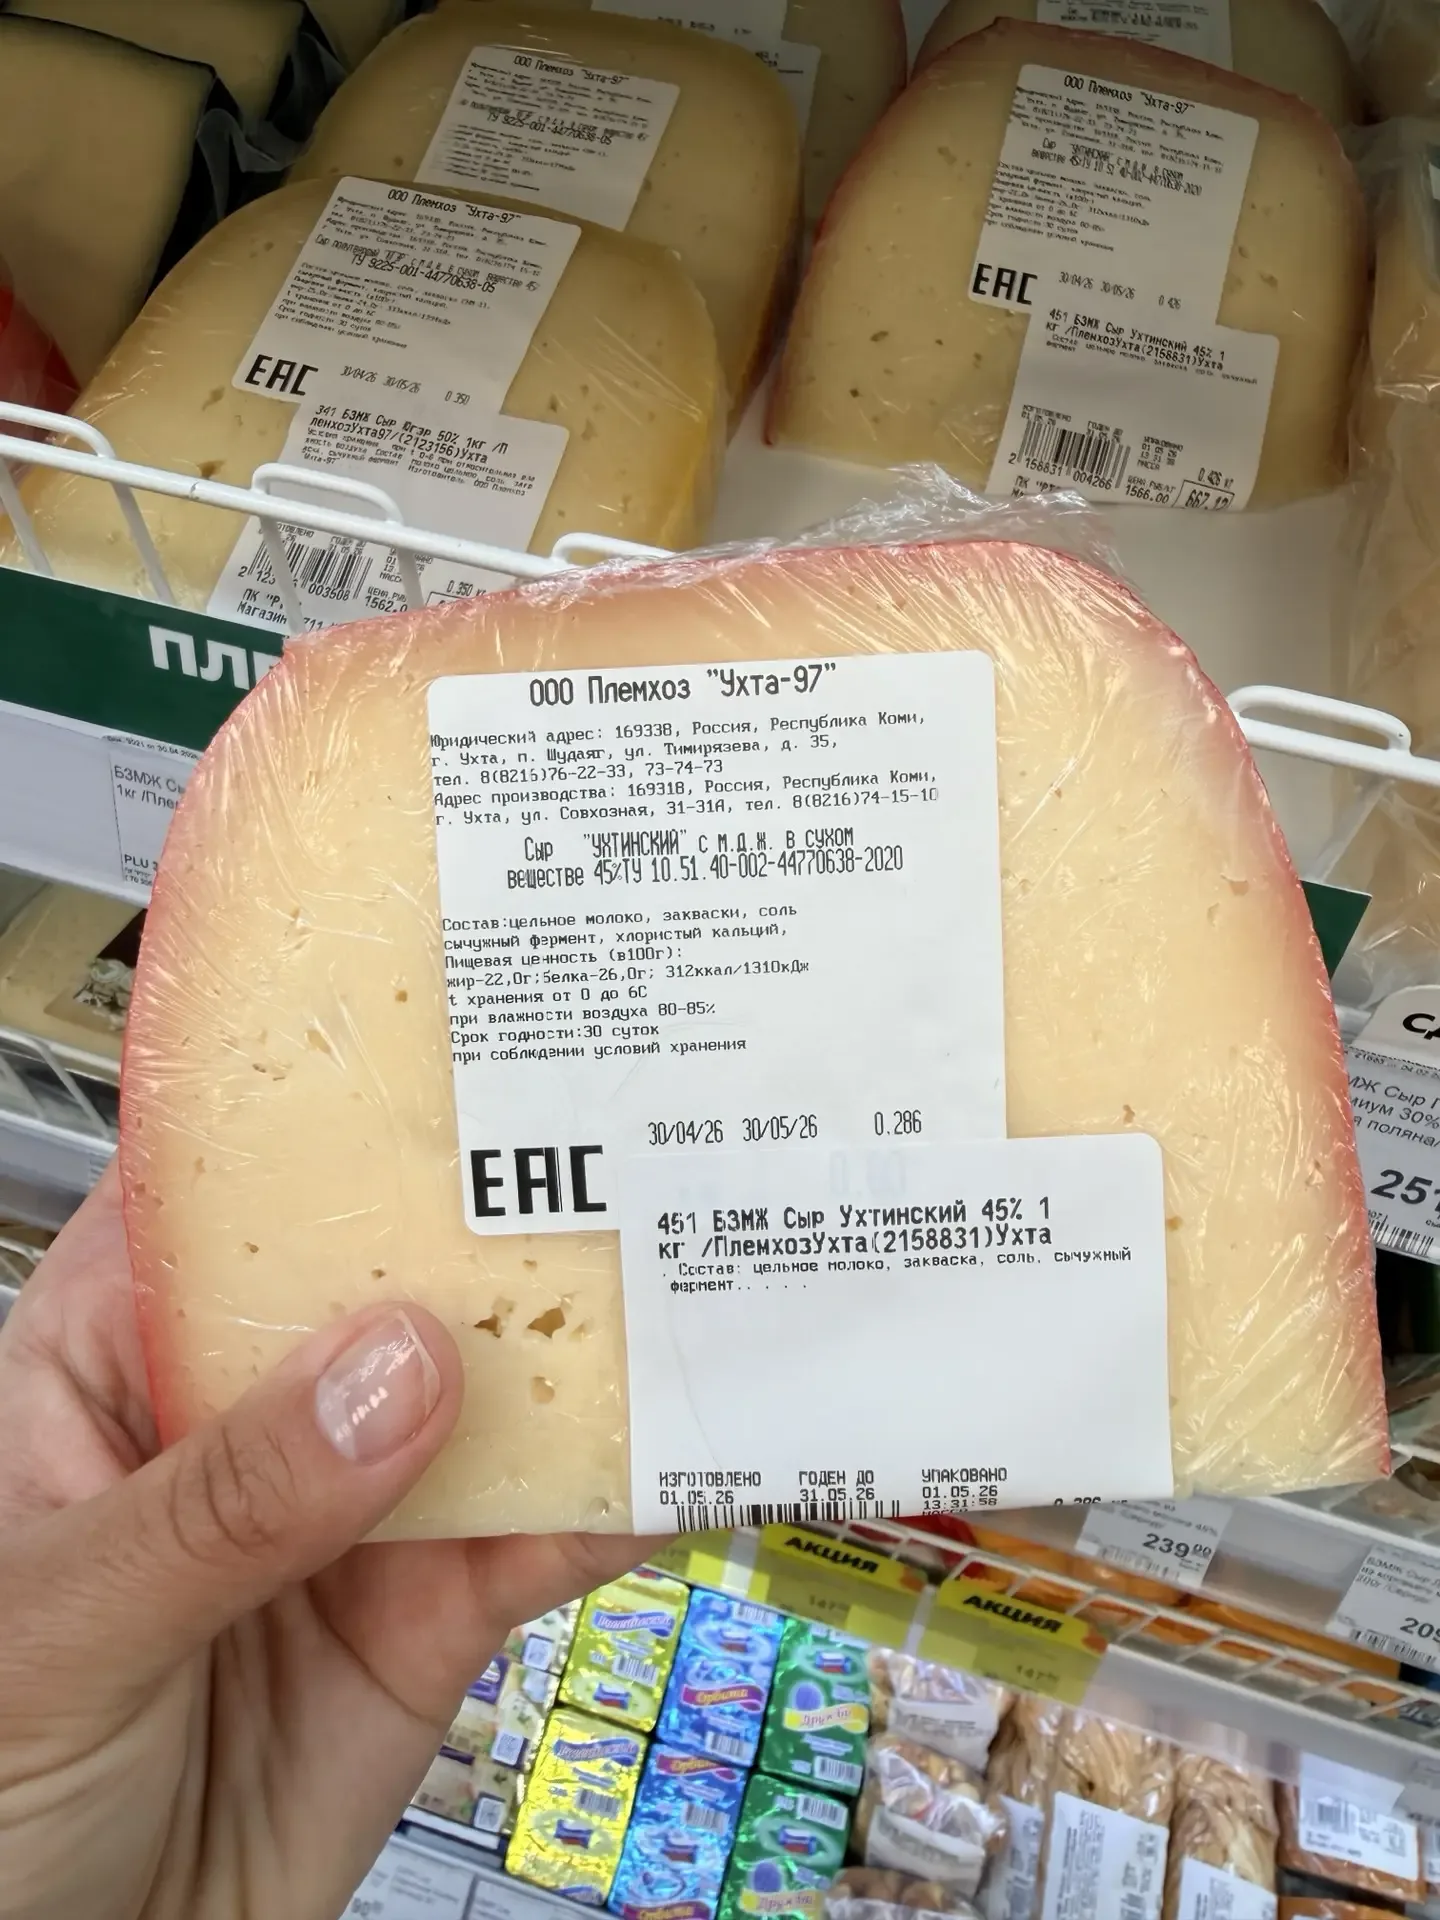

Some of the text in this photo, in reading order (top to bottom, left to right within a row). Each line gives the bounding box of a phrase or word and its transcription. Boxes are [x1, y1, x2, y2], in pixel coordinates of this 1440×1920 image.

[388, 189, 409, 202] ООО
[412, 193, 457, 213] Племхоз
[1050, 309, 1068, 322] 451
[1106, 322, 1124, 335] Сыр
[1220, 351, 1224, 361] 1
[315, 405, 336, 417] 341
[376, 415, 396, 431] Сыр
[437, 430, 460, 444] 50%
[467, 437, 486, 449] 1кг
[1073, 471, 1112, 490] 004266
[1126, 484, 1169, 504] 1566.00
[308, 581, 350, 601] 003508
[530, 663, 836, 707] ООО Племхоз "Ухта-97"
[430, 712, 923, 751] Юридический адрес: 169338, Россия, Республика Коми,
[430, 734, 836, 768] г. Ухта, п. Шудаяг, ул. Тимирязева, д. 35,
[114, 766, 162, 789] БЗМЖ
[434, 776, 468, 786] тел.
[645, 760, 722, 776] 73-74-73
[116, 784, 178, 810] 1кг /Пле
[434, 770, 935, 809] Адрес производства: 169318, Россия, Республика Коми,
[434, 816, 451, 825] г.
[464, 811, 509, 824] Ухта,
[522, 811, 547, 825] ул.
[560, 806, 654, 819] Совхозная,
[746, 800, 780, 810] тел.
[793, 788, 936, 808] 8(8216)74-15-10
[525, 837, 553, 862] Сыр
[584, 830, 686, 858] "УХТИНСКИЙ"
[124, 855, 149, 869] PLU
[508, 867, 584, 889] веществе
[442, 906, 797, 931] Состав:цельное молоко, закваски, соль
[444, 924, 786, 952] сычужный фермент, хлористый кальций,
[445, 943, 681, 970] Пищевая ценность (в100г):
[448, 994, 457, 1006] t
[467, 989, 544, 1008] хранения
[553, 992, 571, 1001] от
[581, 988, 590, 1000] 0
[601, 990, 618, 1002] до
[450, 1002, 715, 1028] при влажности воздуха 80-85%
[451, 1025, 659, 1047] Срок годности:30 суток
[453, 1040, 746, 1065] при соблюдении условий хранения
[1384, 1086, 1425, 1107] Сыр
[648, 1110, 921, 1145] 30/04/26 30/05/26 0.286
[1400, 1107, 1440, 1129] 30%
[658, 1196, 1049, 1235] 451 БЗМЖ Сыр Ухтинский 45% 1
[659, 1223, 1052, 1259] кг /ПлемхозУхта(2158831)Ухта
[679, 1263, 740, 1276] Состав:
[754, 1262, 818, 1275] цельное
[828, 1260, 890, 1271] молоко,
[904, 1256, 983, 1268] закваска,
[1054, 1247, 1131, 1262] сычужный
[660, 1468, 1007, 1488] ИЗГОТОВЛЕНО ГОДЕН ДО УПАКОВАНО
[660, 1485, 998, 1506] 01.05.26 31.05.26 01.05.26
[922, 1498, 997, 1513] 13:31:58
[783, 1536, 880, 1574] АКЦИЯ
[1142, 1533, 1190, 1559] 239
[963, 1595, 1064, 1634] АКЦИЯ
